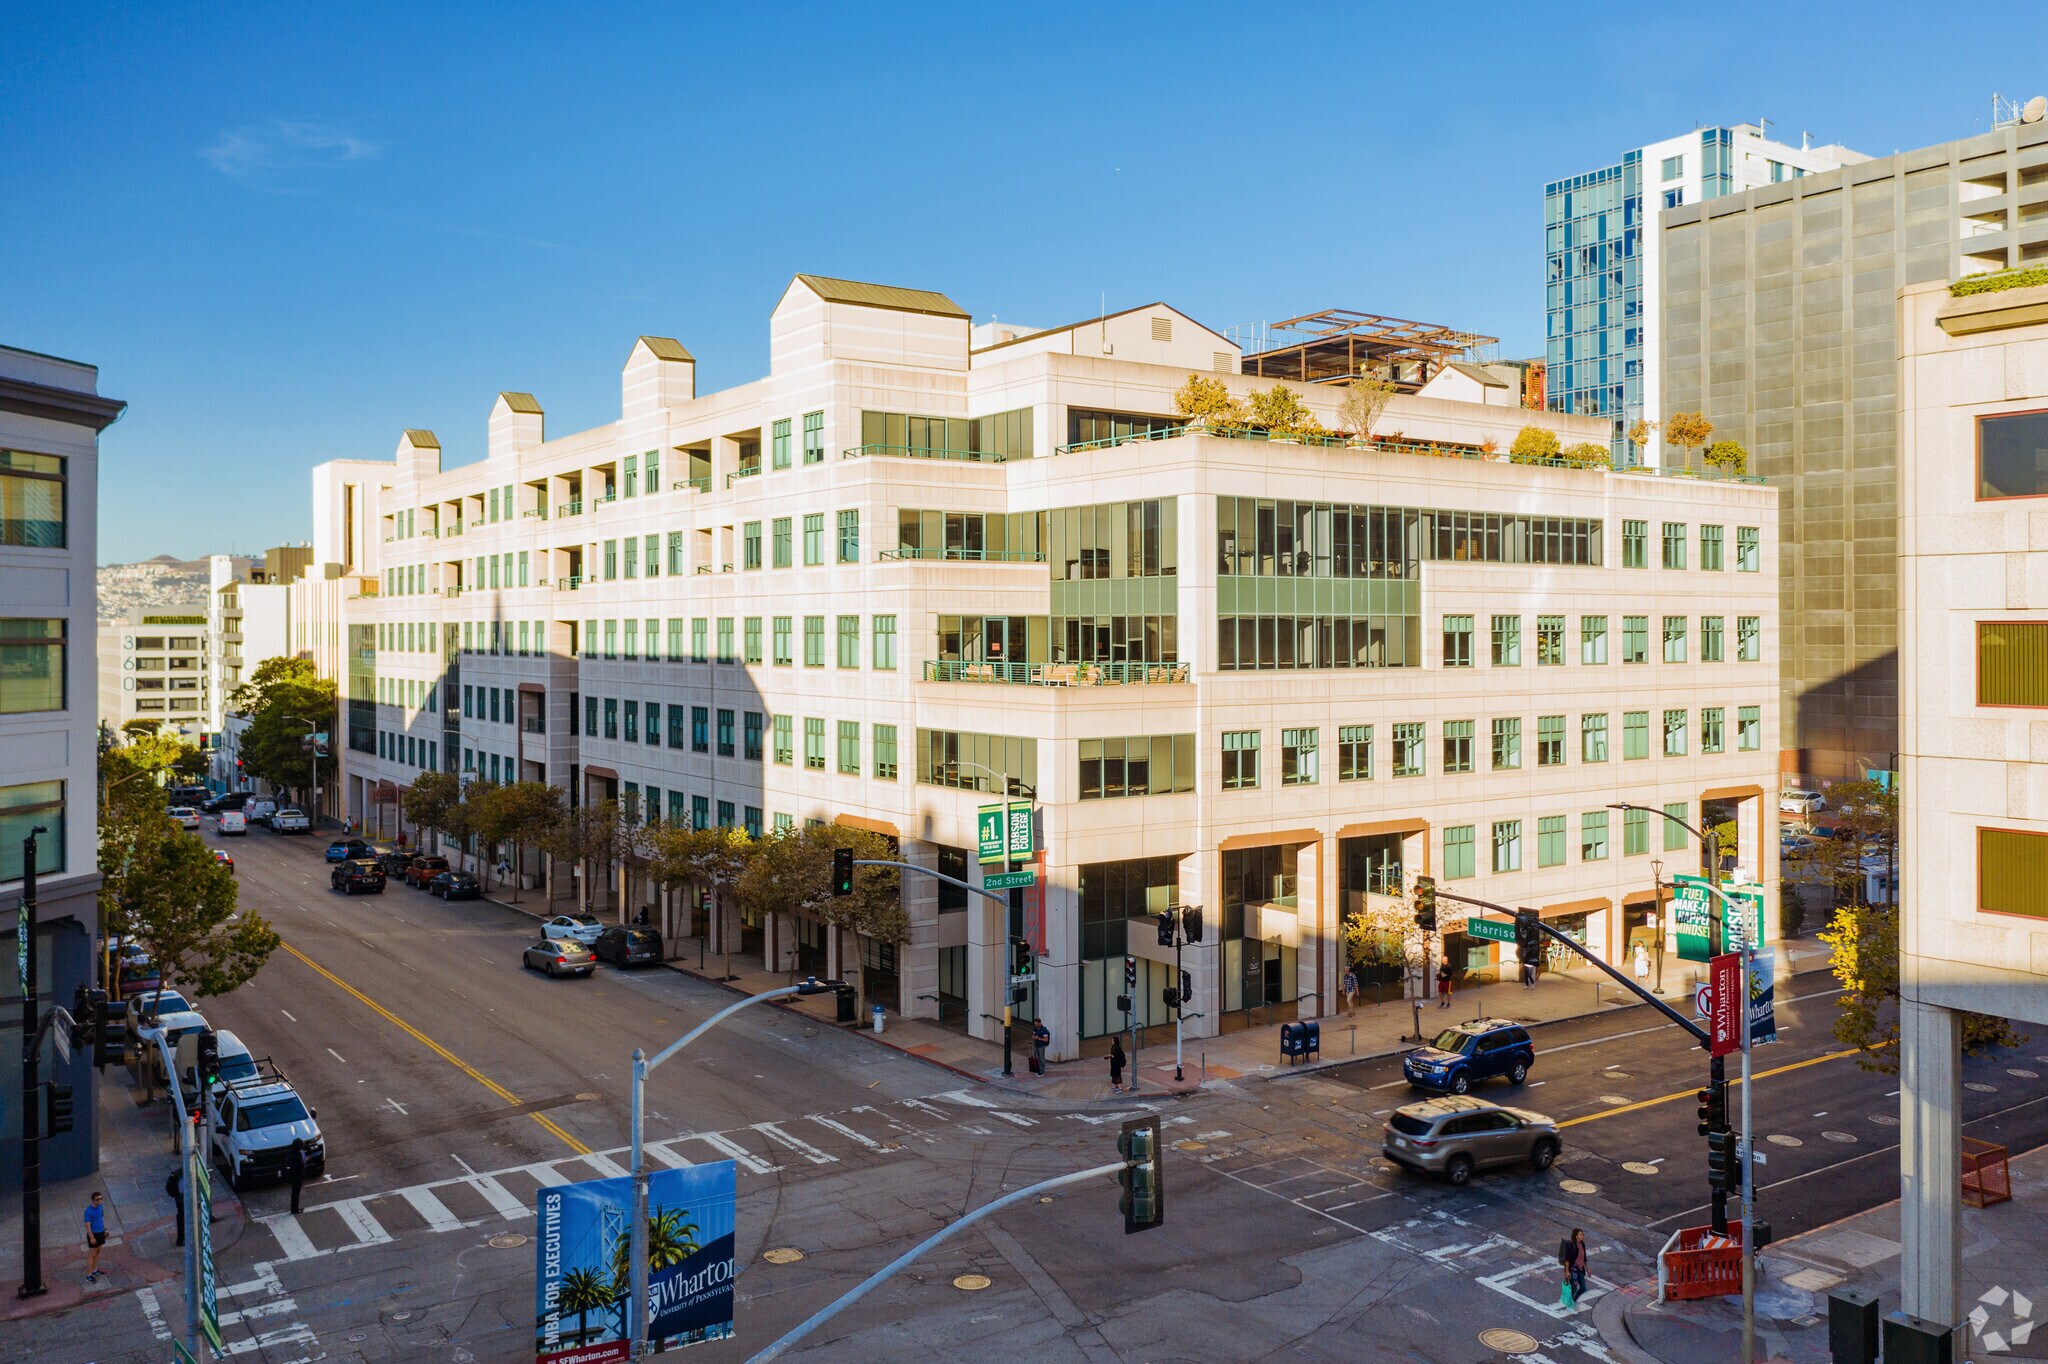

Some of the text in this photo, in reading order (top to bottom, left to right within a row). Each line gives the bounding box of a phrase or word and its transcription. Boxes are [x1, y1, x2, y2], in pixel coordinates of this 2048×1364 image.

[123, 635, 135, 691] 360
[1010, 812, 1020, 851] BABSON
[1020, 811, 1029, 850] COLLEGE
[986, 874, 1032, 887] 2nd Street
[1682, 888, 1704, 902] FUEL
[1474, 922, 1516, 939] Harriso
[1727, 898, 1743, 952] BABSO
[1716, 968, 1726, 1029] Wharton
[545, 1193, 561, 1278] EXECUTIVES
[545, 1280, 560, 1309] FOR
[660, 1301, 688, 1317] UNIVERSITY
[688, 1295, 696, 1308] of
[545, 1311, 560, 1346] MBA
[559, 1348, 619, 1364] SFWharton.com
